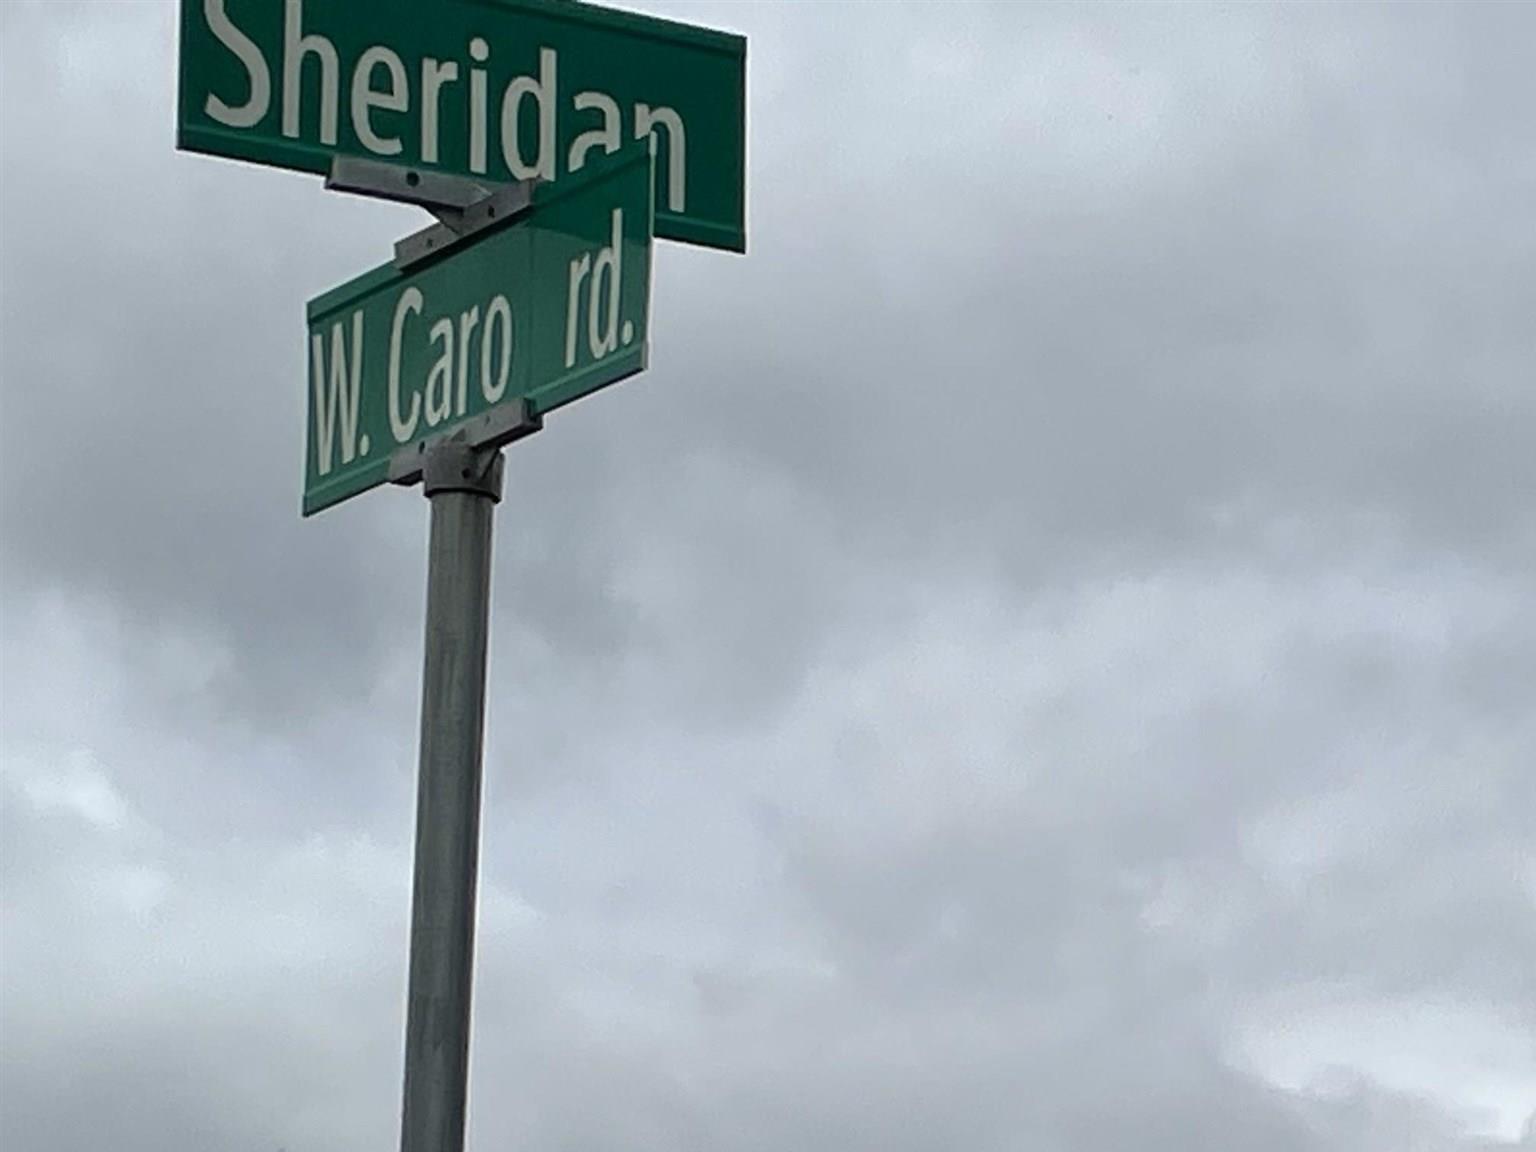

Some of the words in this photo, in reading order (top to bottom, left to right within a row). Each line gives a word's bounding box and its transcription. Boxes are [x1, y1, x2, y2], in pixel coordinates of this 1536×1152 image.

[203, 0, 686, 213] Sheridan
[312, 309, 370, 476] W.
[388, 286, 513, 442] Caro
[565, 207, 633, 368] rd.
